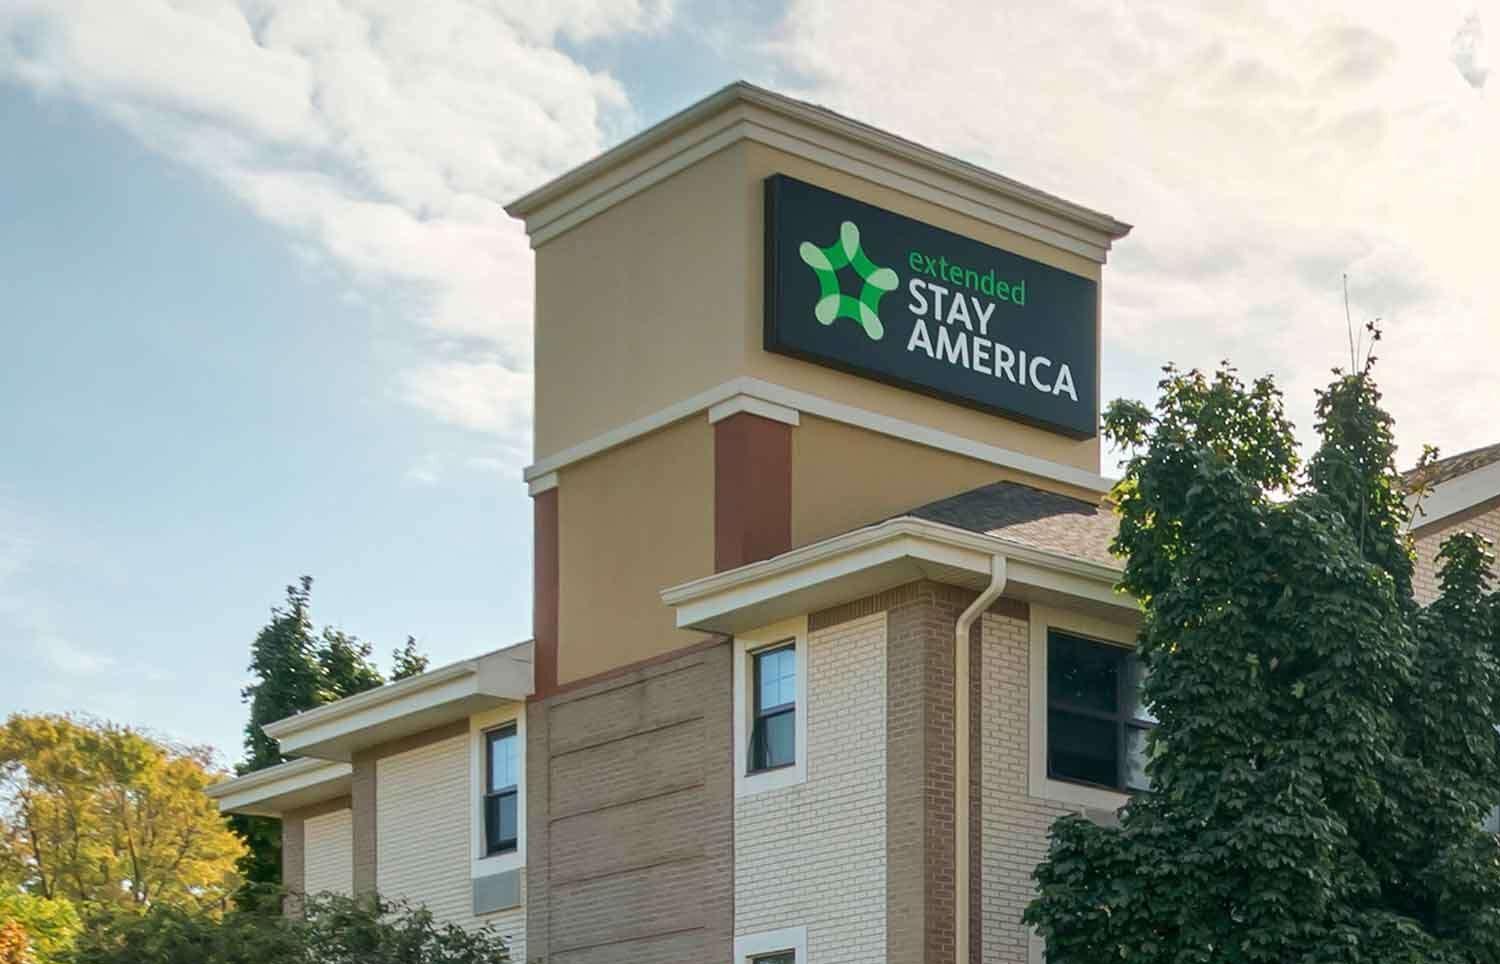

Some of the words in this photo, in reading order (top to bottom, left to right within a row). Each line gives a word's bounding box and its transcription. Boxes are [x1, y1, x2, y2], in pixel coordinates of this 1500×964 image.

[909, 251, 1025, 304] extended
[908, 278, 995, 335] STAY
[906, 319, 1079, 401] AMERICA
